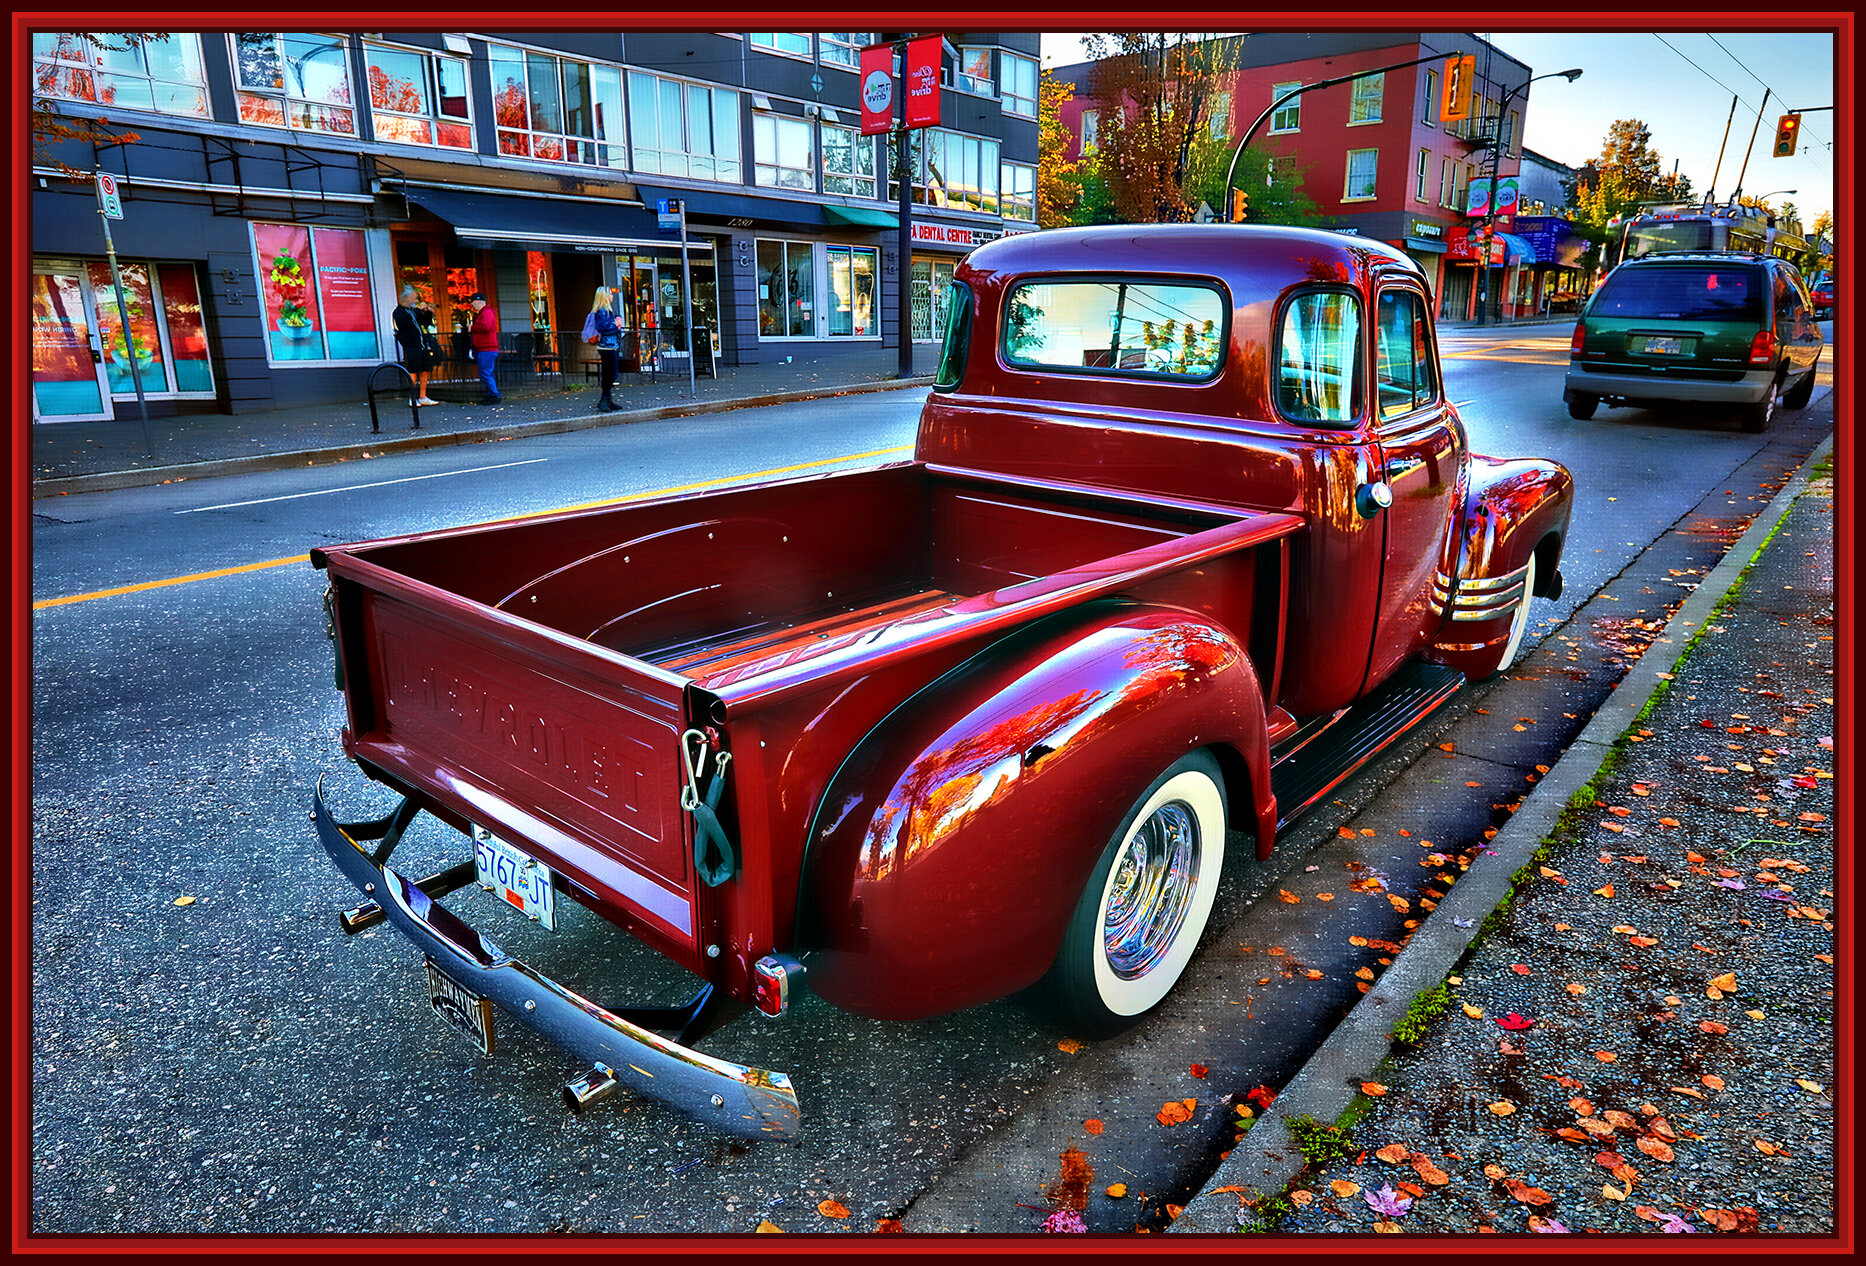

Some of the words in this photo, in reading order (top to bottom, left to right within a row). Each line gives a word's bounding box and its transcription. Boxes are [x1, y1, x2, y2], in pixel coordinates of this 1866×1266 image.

[727, 218, 753, 227] 1280
[919, 225, 945, 241] DENTAL
[947, 228, 972, 244] CENTRE
[388, 656, 645, 813] CHEVROLET
[476, 840, 516, 891] 5767
[529, 875, 549, 912] JT
